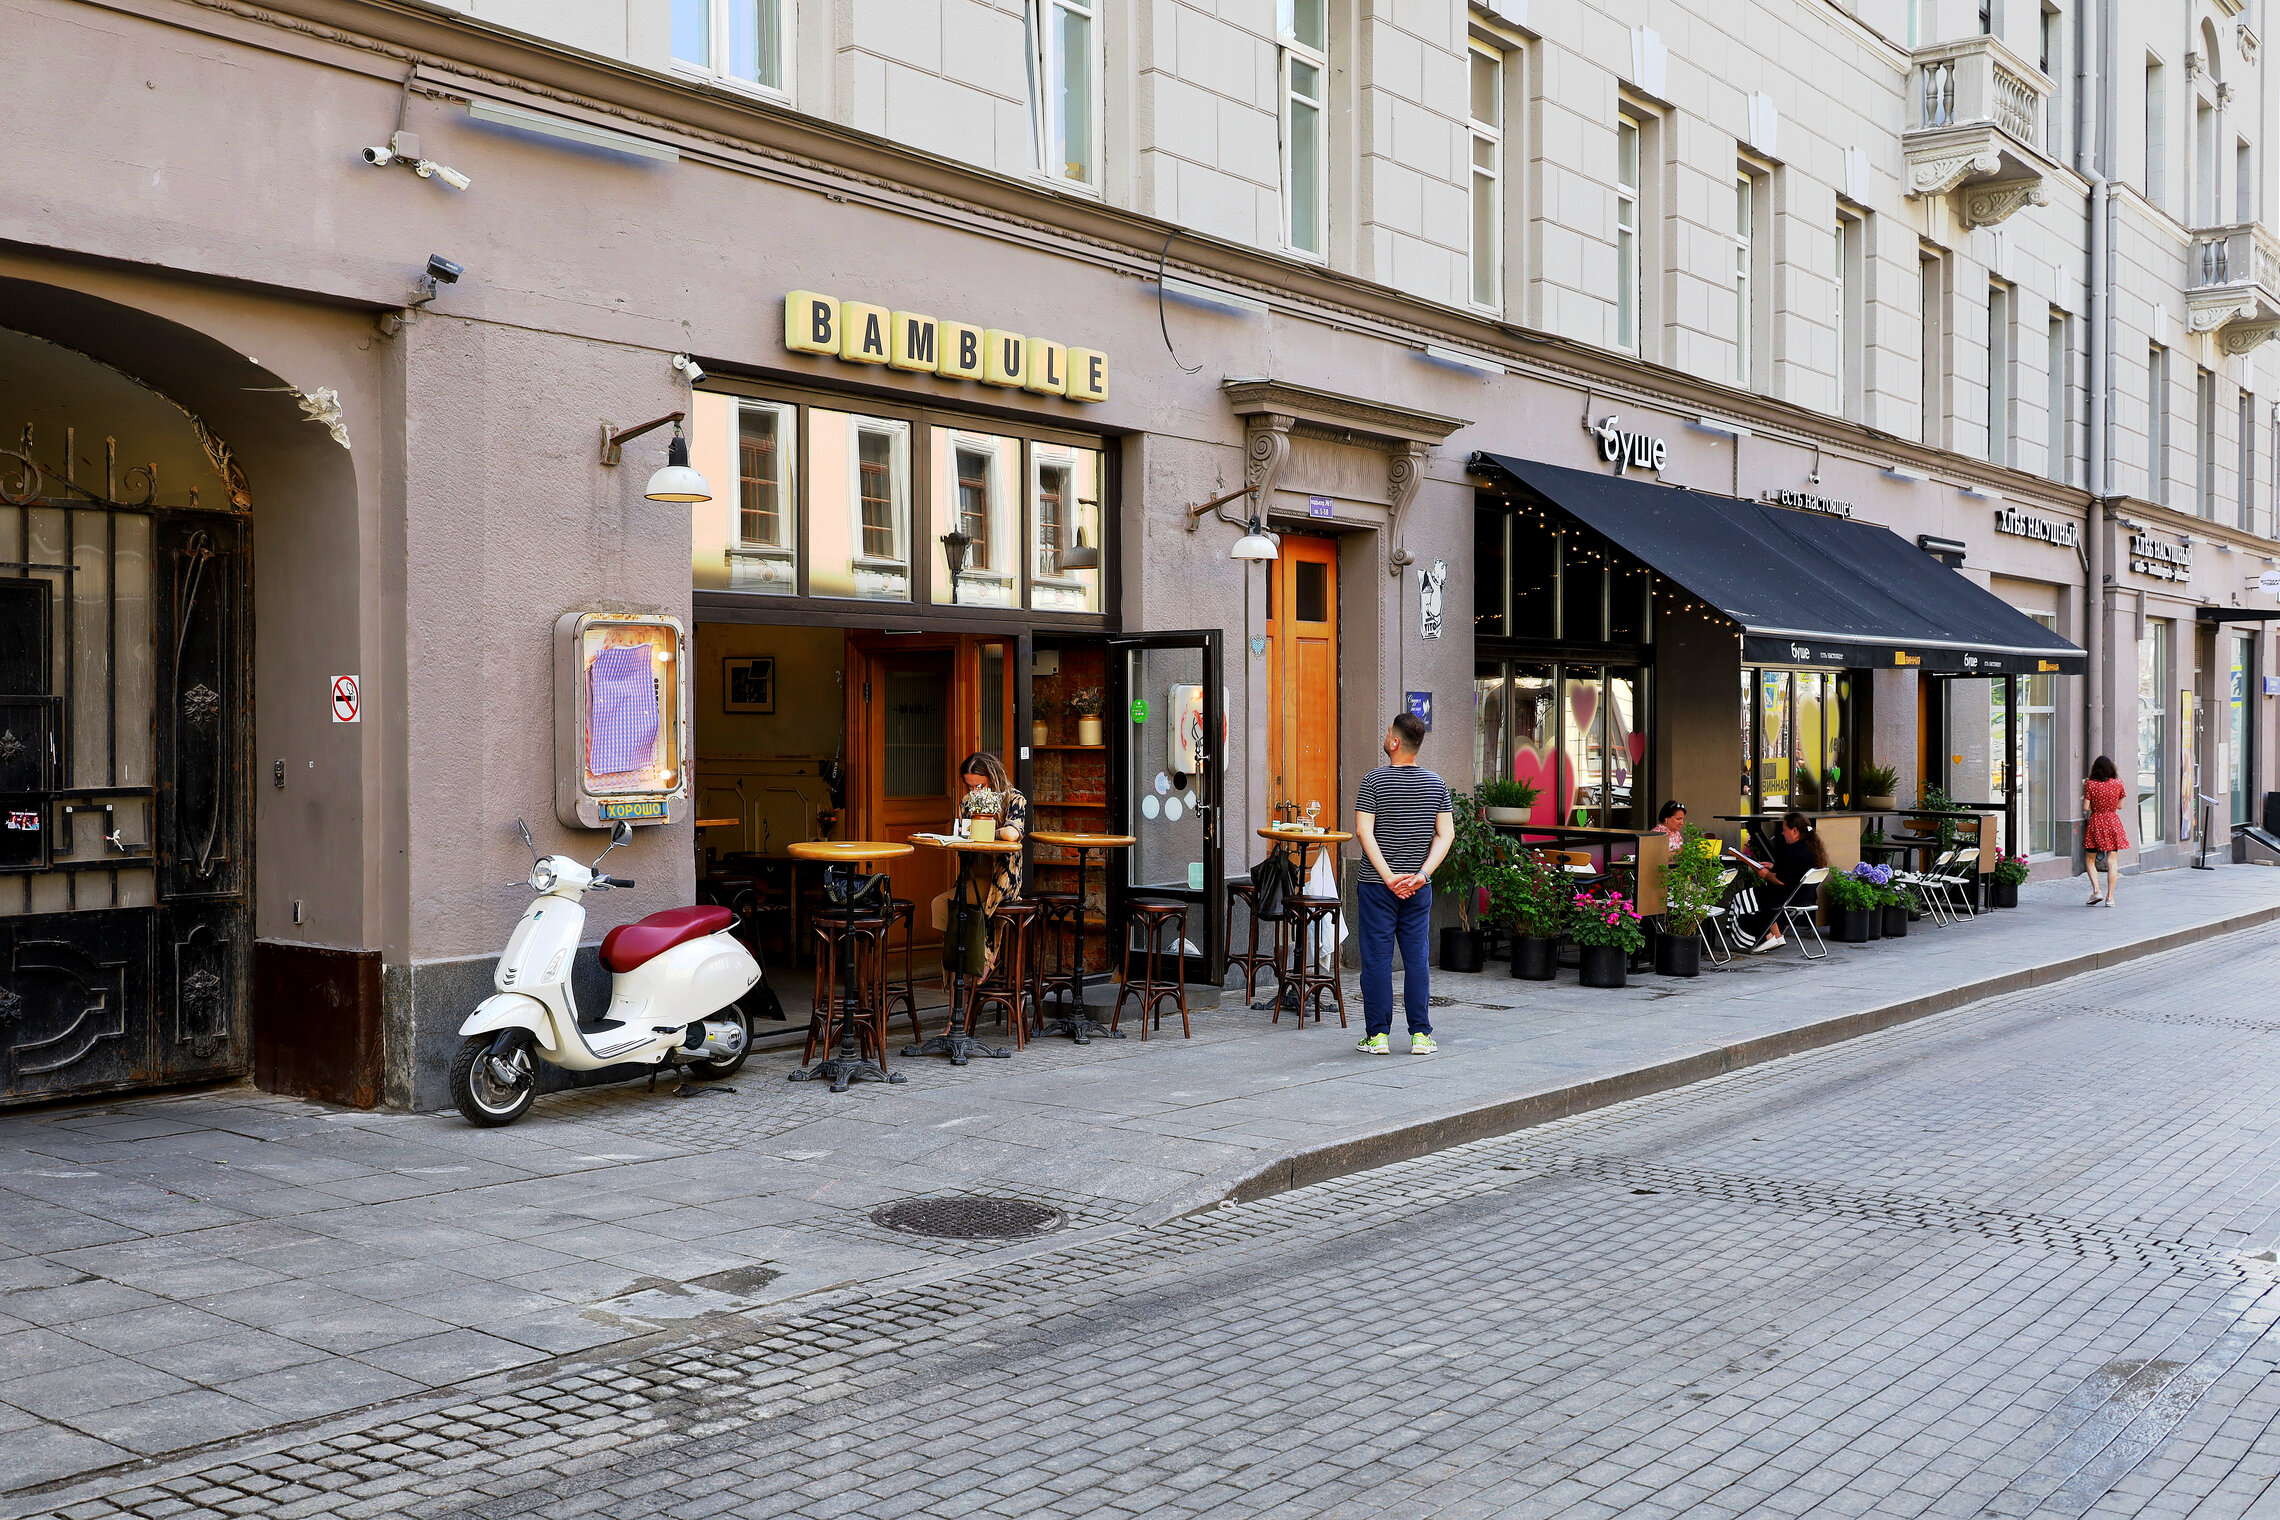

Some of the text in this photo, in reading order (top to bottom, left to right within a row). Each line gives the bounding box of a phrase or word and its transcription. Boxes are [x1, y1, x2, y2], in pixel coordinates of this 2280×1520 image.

[812, 300, 1102, 394] BAMBULE
[1604, 415, 1666, 475] буше
[1782, 488, 1855, 519] есть настоящее
[2028, 516, 2078, 547] НАСУЩНЫЙ
[1791, 642, 1811, 662] буше
[1762, 779, 1789, 793] ВИННАЯ
[608, 803, 660, 817] ХОРОШО
